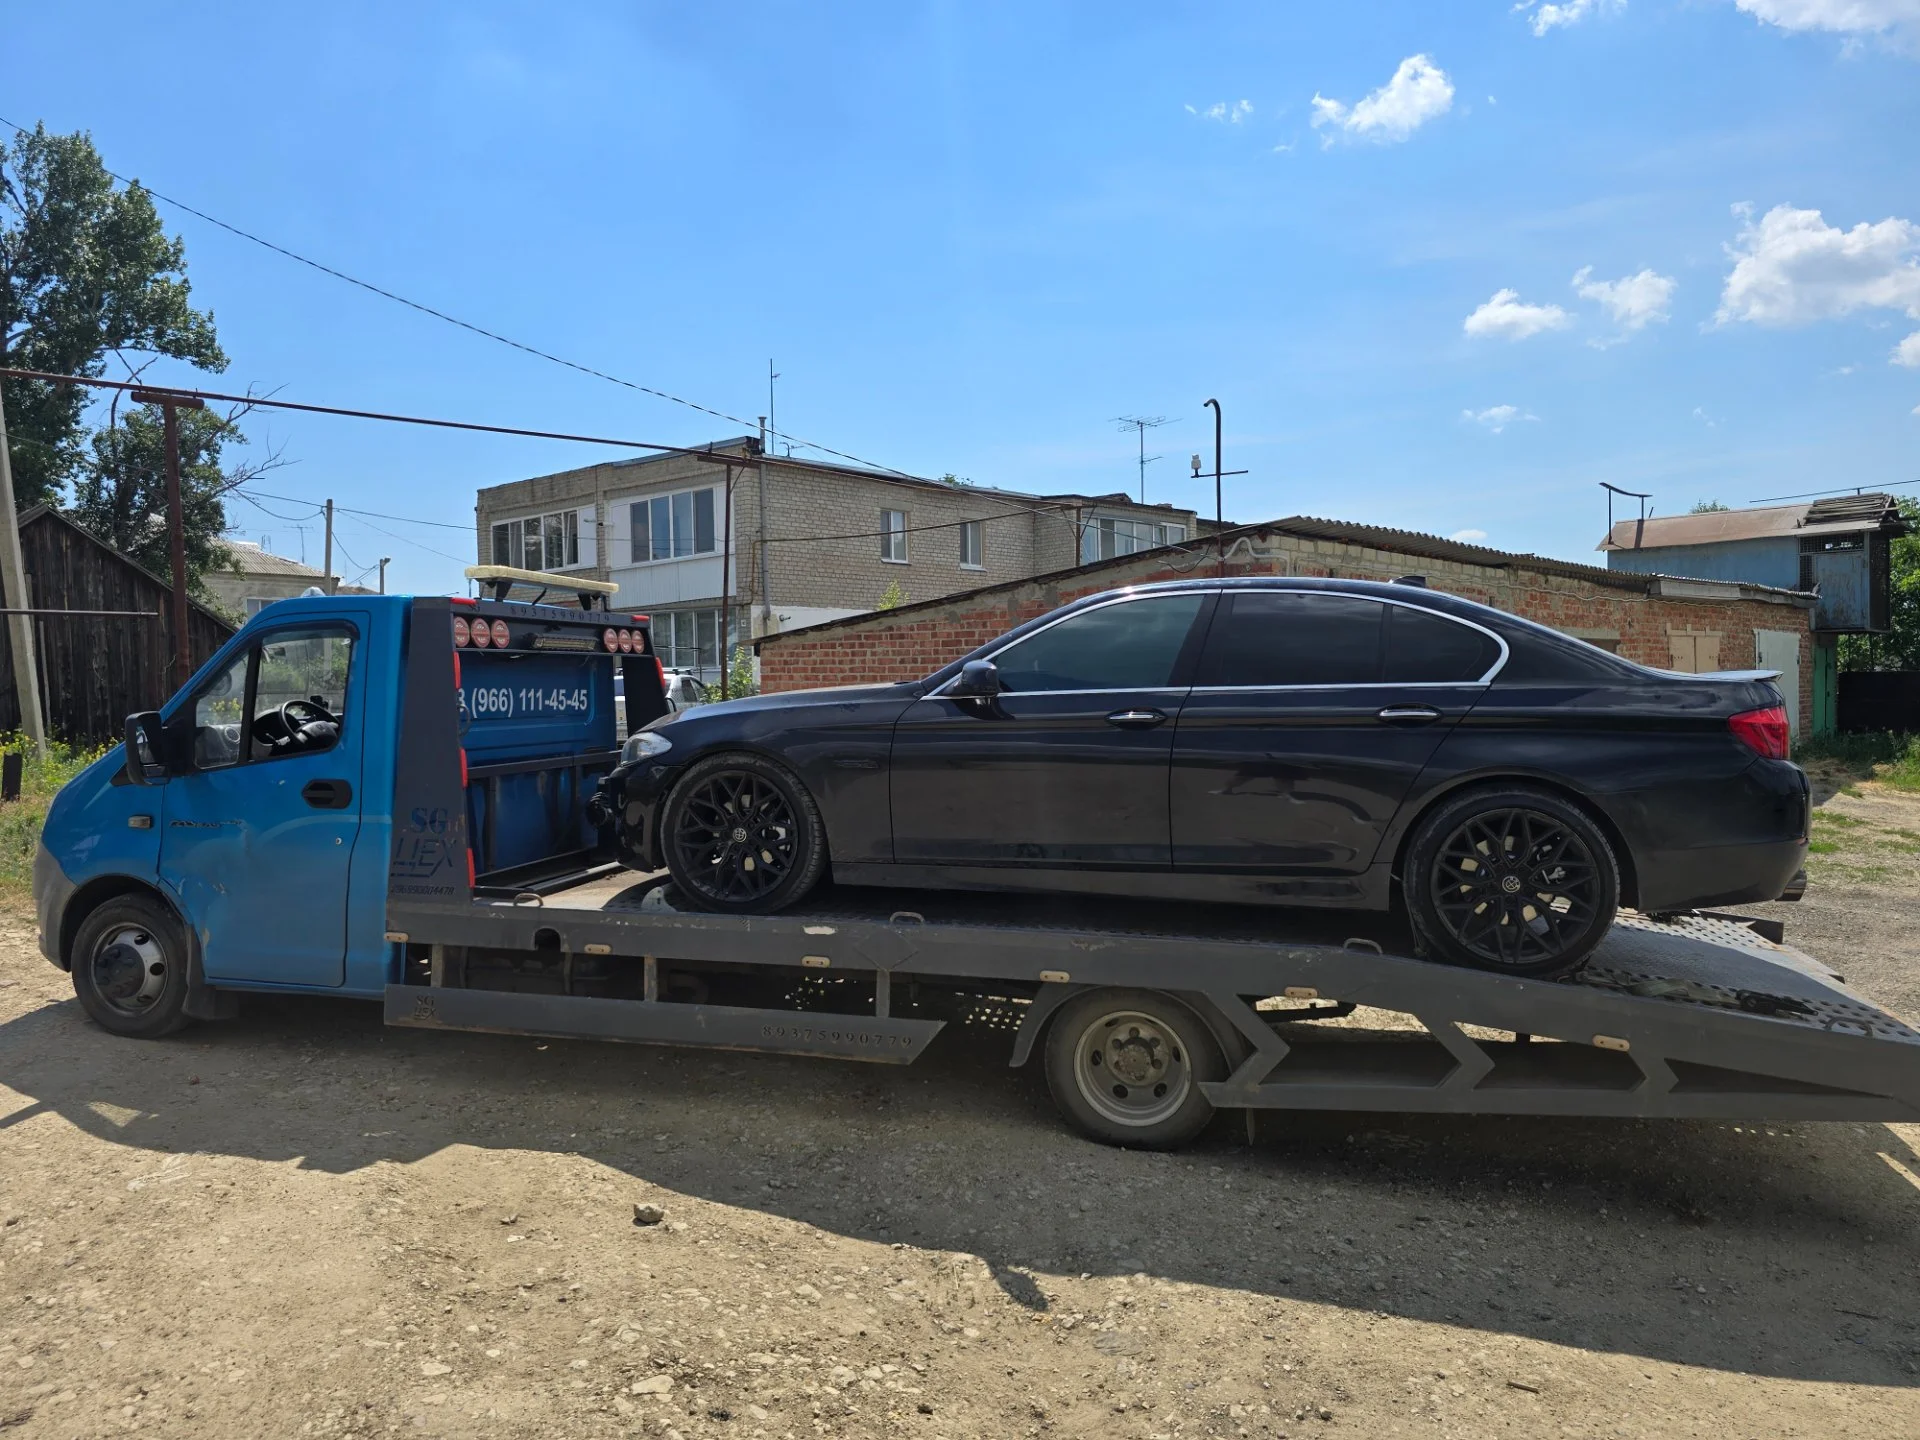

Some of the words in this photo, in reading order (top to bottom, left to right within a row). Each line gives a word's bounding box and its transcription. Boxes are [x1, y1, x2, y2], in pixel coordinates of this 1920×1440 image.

[471, 687, 514, 718] (966)
[519, 688, 588, 711] 111-45-45
[411, 807, 448, 834] SG
[762, 1025, 912, 1047] 89375990779
